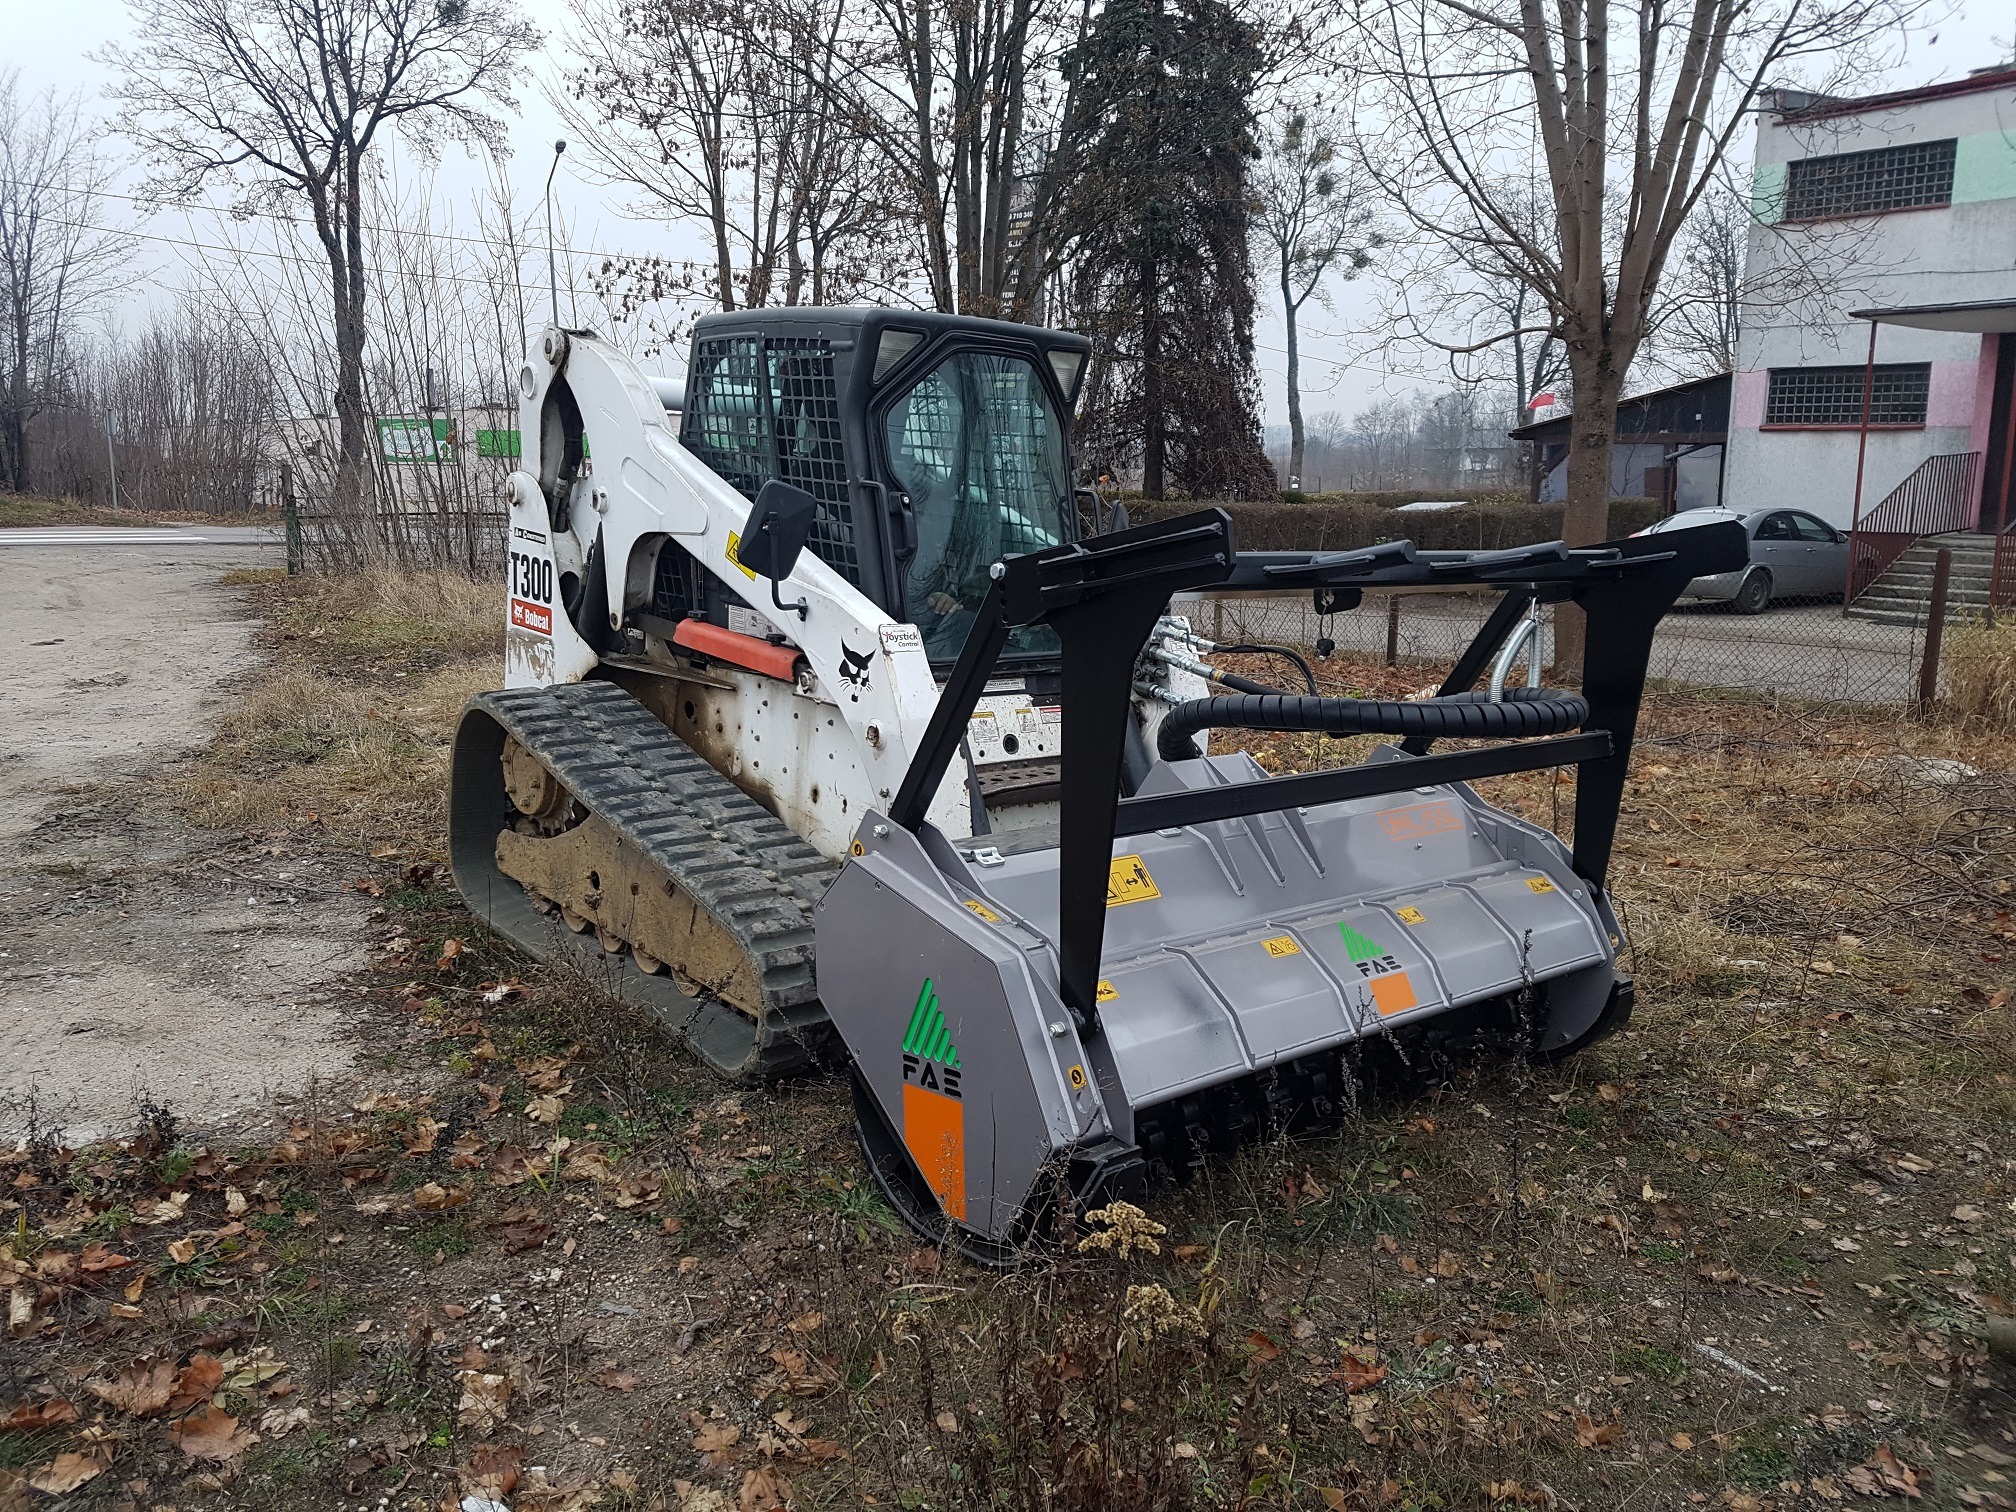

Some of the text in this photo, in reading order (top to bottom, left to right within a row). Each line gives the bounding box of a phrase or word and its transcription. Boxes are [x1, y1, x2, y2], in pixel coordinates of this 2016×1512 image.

[511, 551, 552, 604] T300
[525, 608, 550, 631] Bobcat
[1356, 955, 1402, 978] FAE
[903, 1053, 962, 1098] FAE
